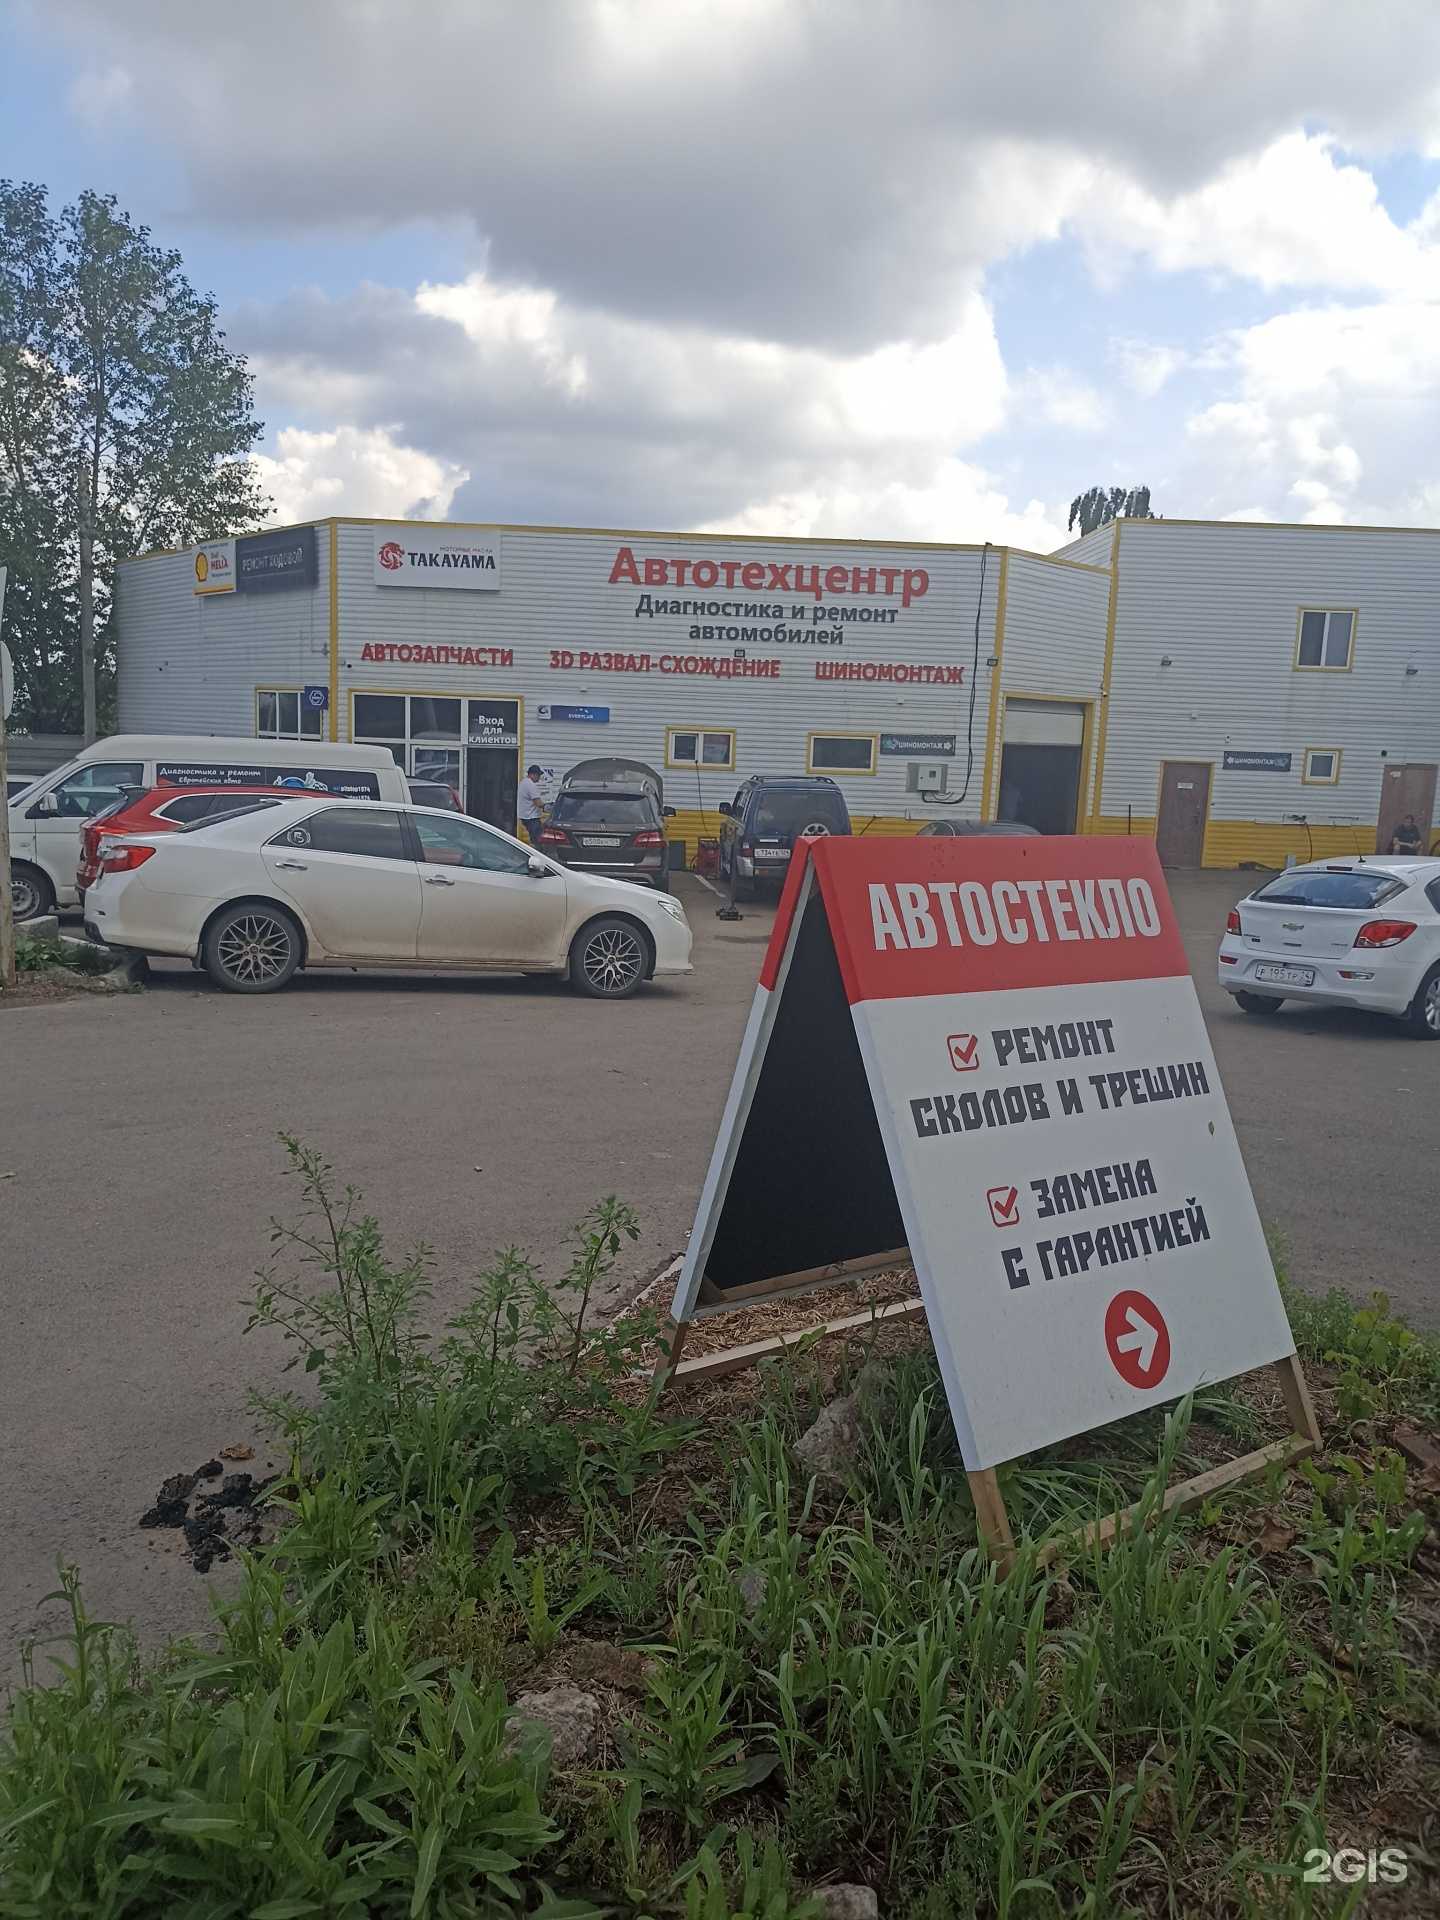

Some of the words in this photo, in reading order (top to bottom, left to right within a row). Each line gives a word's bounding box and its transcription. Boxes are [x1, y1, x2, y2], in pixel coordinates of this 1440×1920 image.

[408, 552, 496, 570] TAKAYAMA
[608, 547, 929, 608] Автотехцентр
[635, 594, 784, 619] Диагностика
[791, 605, 805, 620] и
[813, 605, 898, 625] ремонт
[689, 622, 844, 645] автомобилей
[361, 642, 514, 667] АВТОЗАПЧАСТИ
[550, 650, 574, 669] 3D
[579, 651, 781, 679] РАЗВАЛ-СХОЖДЕНИЕ
[815, 661, 965, 684] ШИНОМОНТАЖ
[478, 715, 505, 726] Вход
[482, 726, 502, 735] для
[468, 735, 518, 745] клиентов
[868, 877, 1162, 951] АВТОСТЕКЛО
[991, 1019, 1114, 1067] РЕМОНТ
[909, 1082, 1051, 1138] СКОЛОВ
[1063, 1078, 1084, 1116] И
[1089, 1061, 1210, 1111] ТРЕЩИН
[1030, 1158, 1158, 1219] ЗАМЕНА
[1001, 1246, 1031, 1290] С
[1036, 1196, 1211, 1282] ГАРАНТИЕЙ
